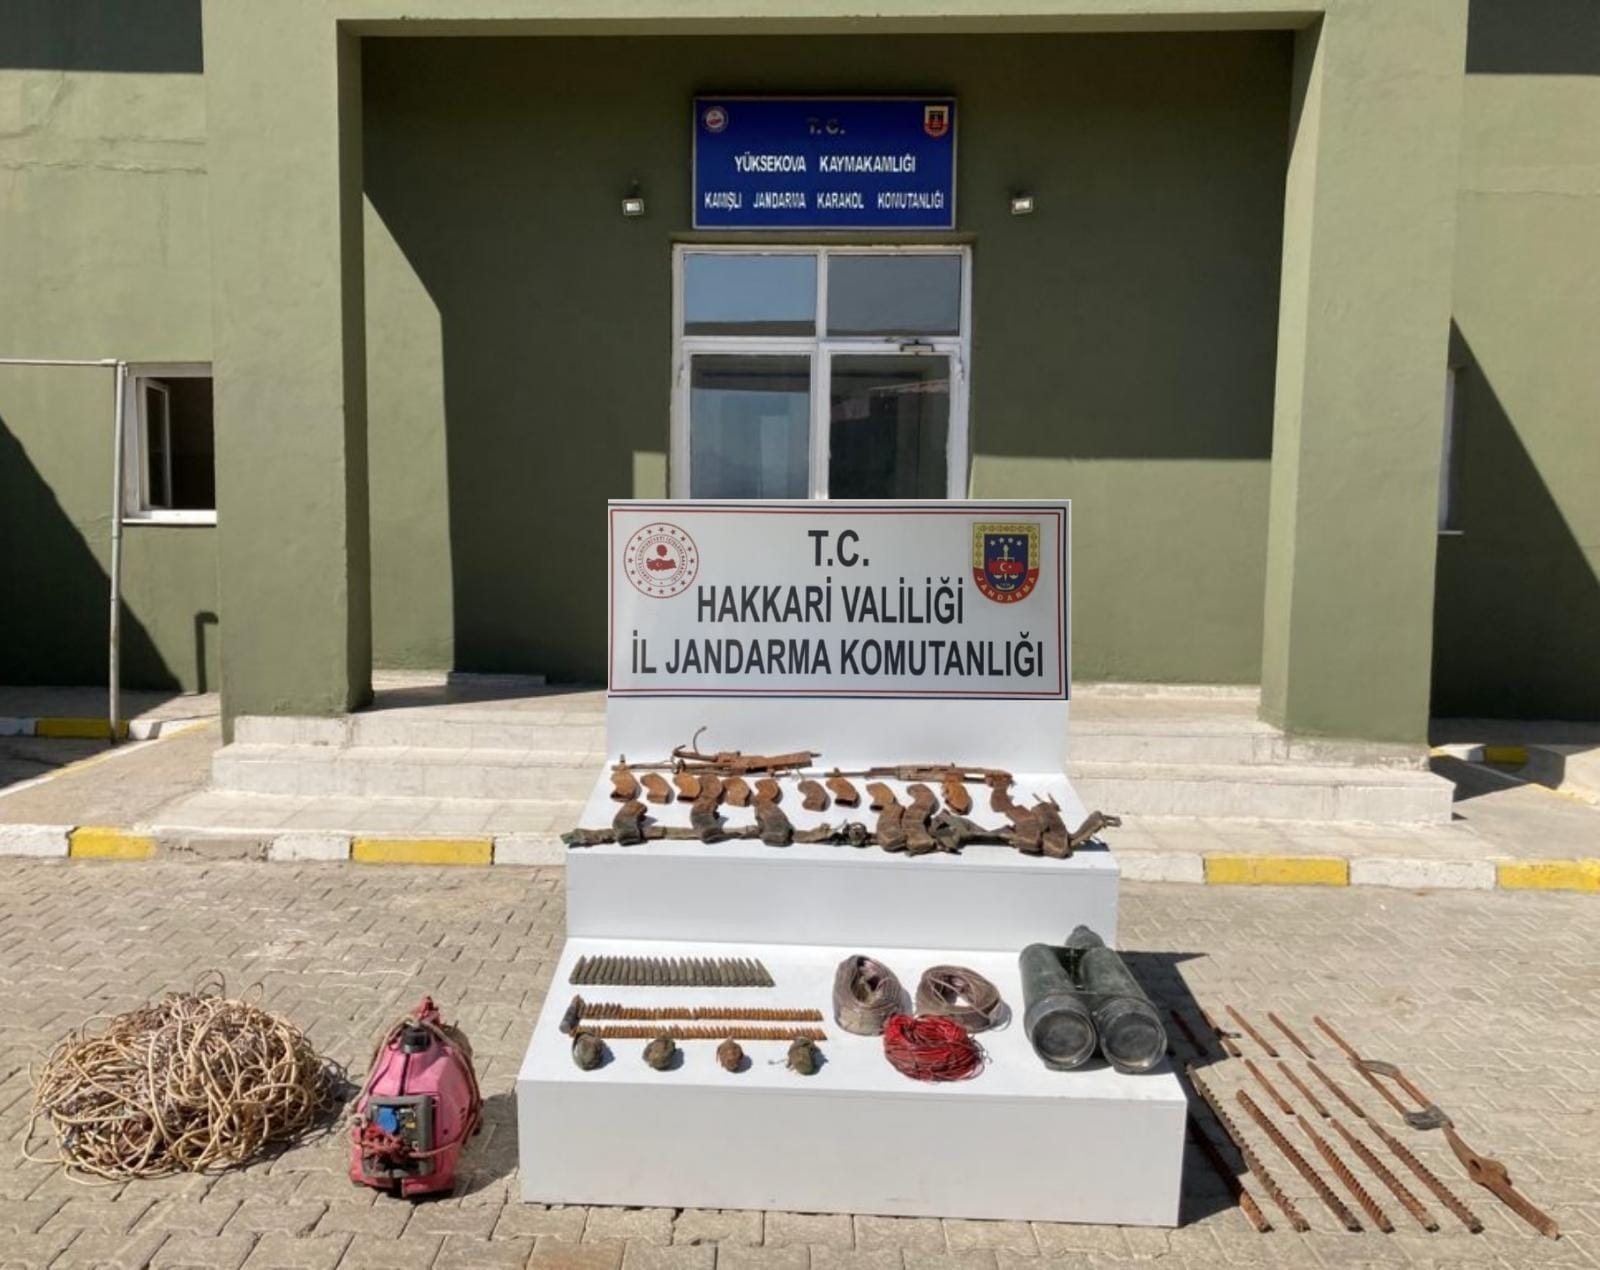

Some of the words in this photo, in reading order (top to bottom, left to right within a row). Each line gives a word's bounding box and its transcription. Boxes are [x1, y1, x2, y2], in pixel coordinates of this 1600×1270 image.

[734, 151, 807, 173] YÜKSEKOVA
[819, 153, 917, 173] KAYMAKAMLIĞI
[752, 191, 807, 210] JANDARMA
[816, 191, 865, 210] KARAKOL
[877, 190, 945, 210] KOMUTANLIĞI
[808, 529, 870, 568] T.C.
[697, 577, 831, 623] HAKKARİ
[841, 577, 963, 624] VALİLİĞİ
[976, 576, 1036, 601] JANDARMA
[631, 630, 656, 674] İL
[665, 638, 832, 675] JANDARMA
[840, 631, 1044, 678] KOMUTANLIĞI
